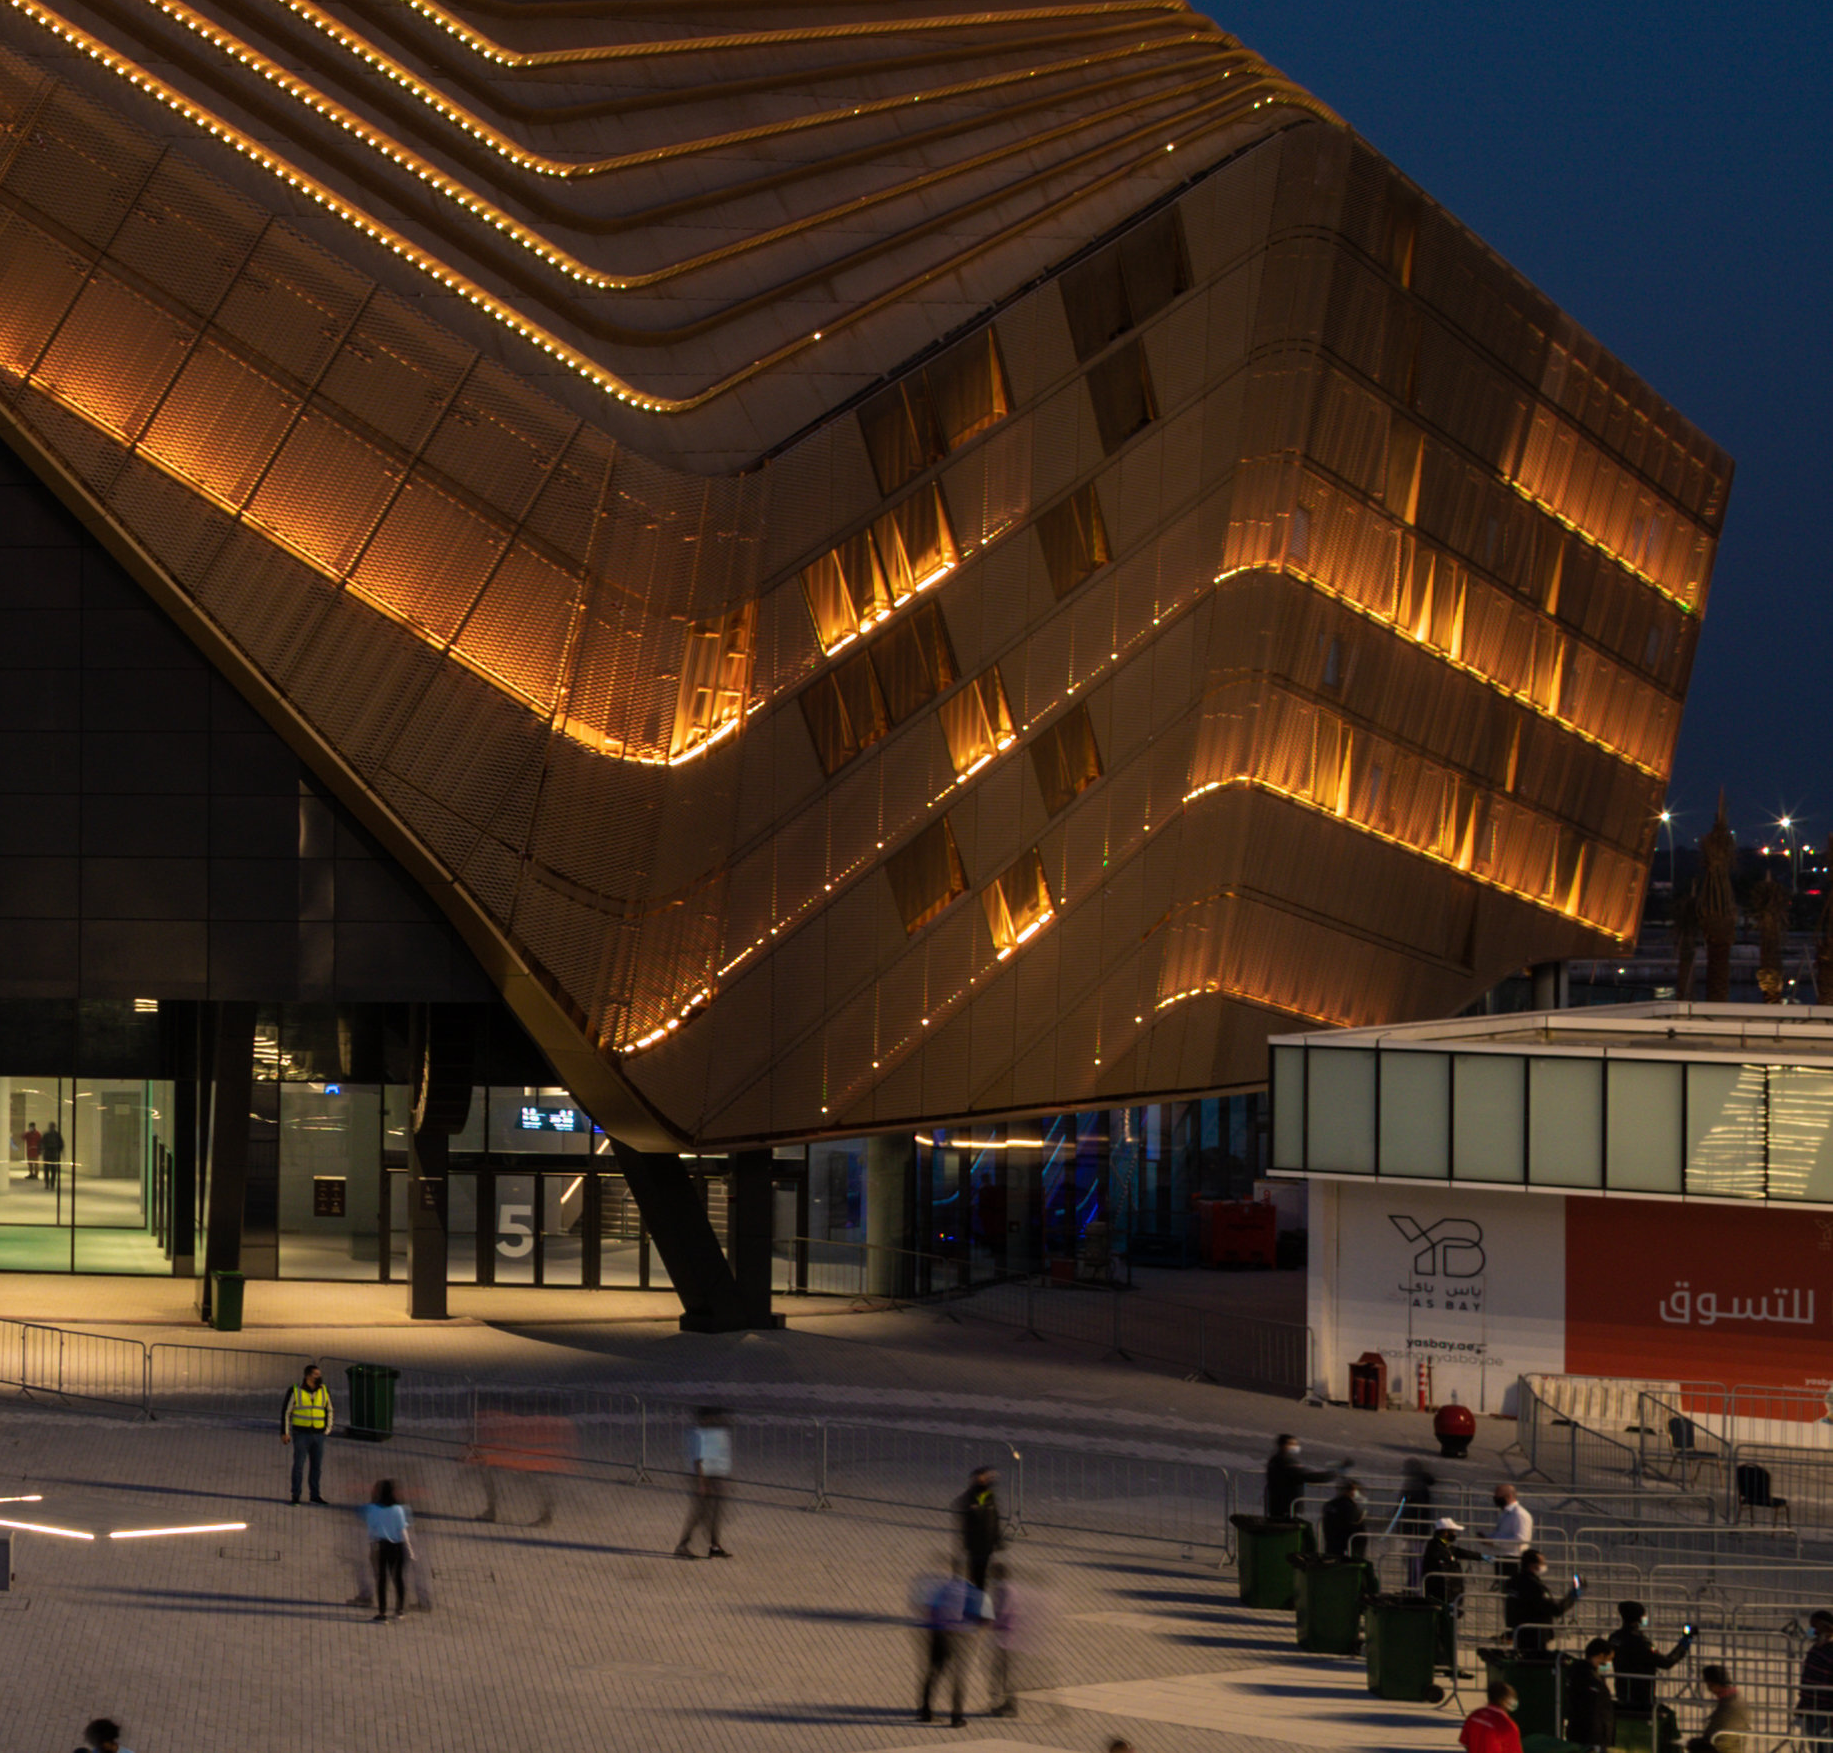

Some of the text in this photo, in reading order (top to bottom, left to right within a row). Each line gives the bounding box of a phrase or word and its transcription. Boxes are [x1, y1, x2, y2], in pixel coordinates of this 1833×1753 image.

[495, 1203, 535, 1259] 5
[1411, 1299, 1481, 1312] AS BAY
[1659, 1280, 1815, 1327] للتسوق
[1406, 1337, 1476, 1352] yasbay.ae
